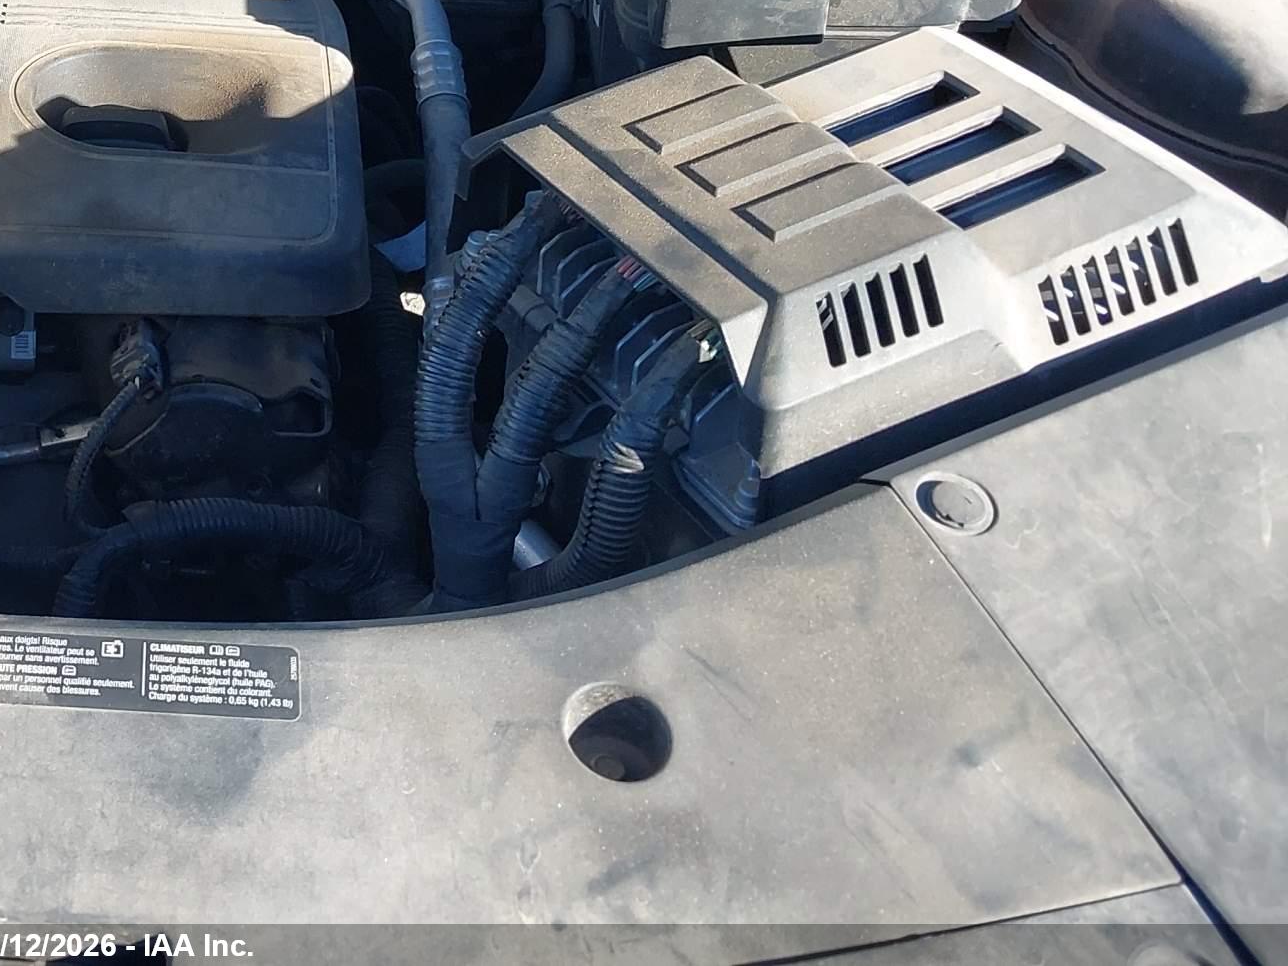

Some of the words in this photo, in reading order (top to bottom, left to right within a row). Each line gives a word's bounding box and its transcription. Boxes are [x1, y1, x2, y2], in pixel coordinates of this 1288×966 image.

[42, 637, 68, 647] Risque
[14, 644, 24, 652] Le
[25, 645, 65, 654] ventilateur
[66, 648, 84, 656] peut
[149, 643, 205, 654] CLIMATISEUR
[44, 655, 99, 665] avertissement.
[150, 654, 176, 663] Utiliser
[178, 657, 218, 666] seulement
[219, 658, 227, 667] le
[228, 659, 250, 668] fluide
[16, 664, 57, 675] PRESSION
[149, 664, 191, 674] frigorigène
[192, 666, 221, 675] R-134a
[223, 668, 231, 676] et
[232, 669, 242, 677] de
[24, 675, 62, 684] personnel
[63, 676, 91, 686] qualifié
[93, 678, 135, 688] seulement.
[232, 678, 253, 687] (huile
[46, 685, 61, 694] des
[62, 686, 101, 696] blessures.
[149, 682, 158, 690] Le
[160, 683, 192, 692] système
[194, 686, 226, 695] contient
[239, 688, 272, 697] colorant.
[149, 692, 176, 702] Charge
[190, 694, 222, 704] système
[228, 696, 247, 705] 0,65
[248, 697, 259, 707] kg
[260, 698, 281, 707] (1,43
[282, 699, 293, 709] lb)
